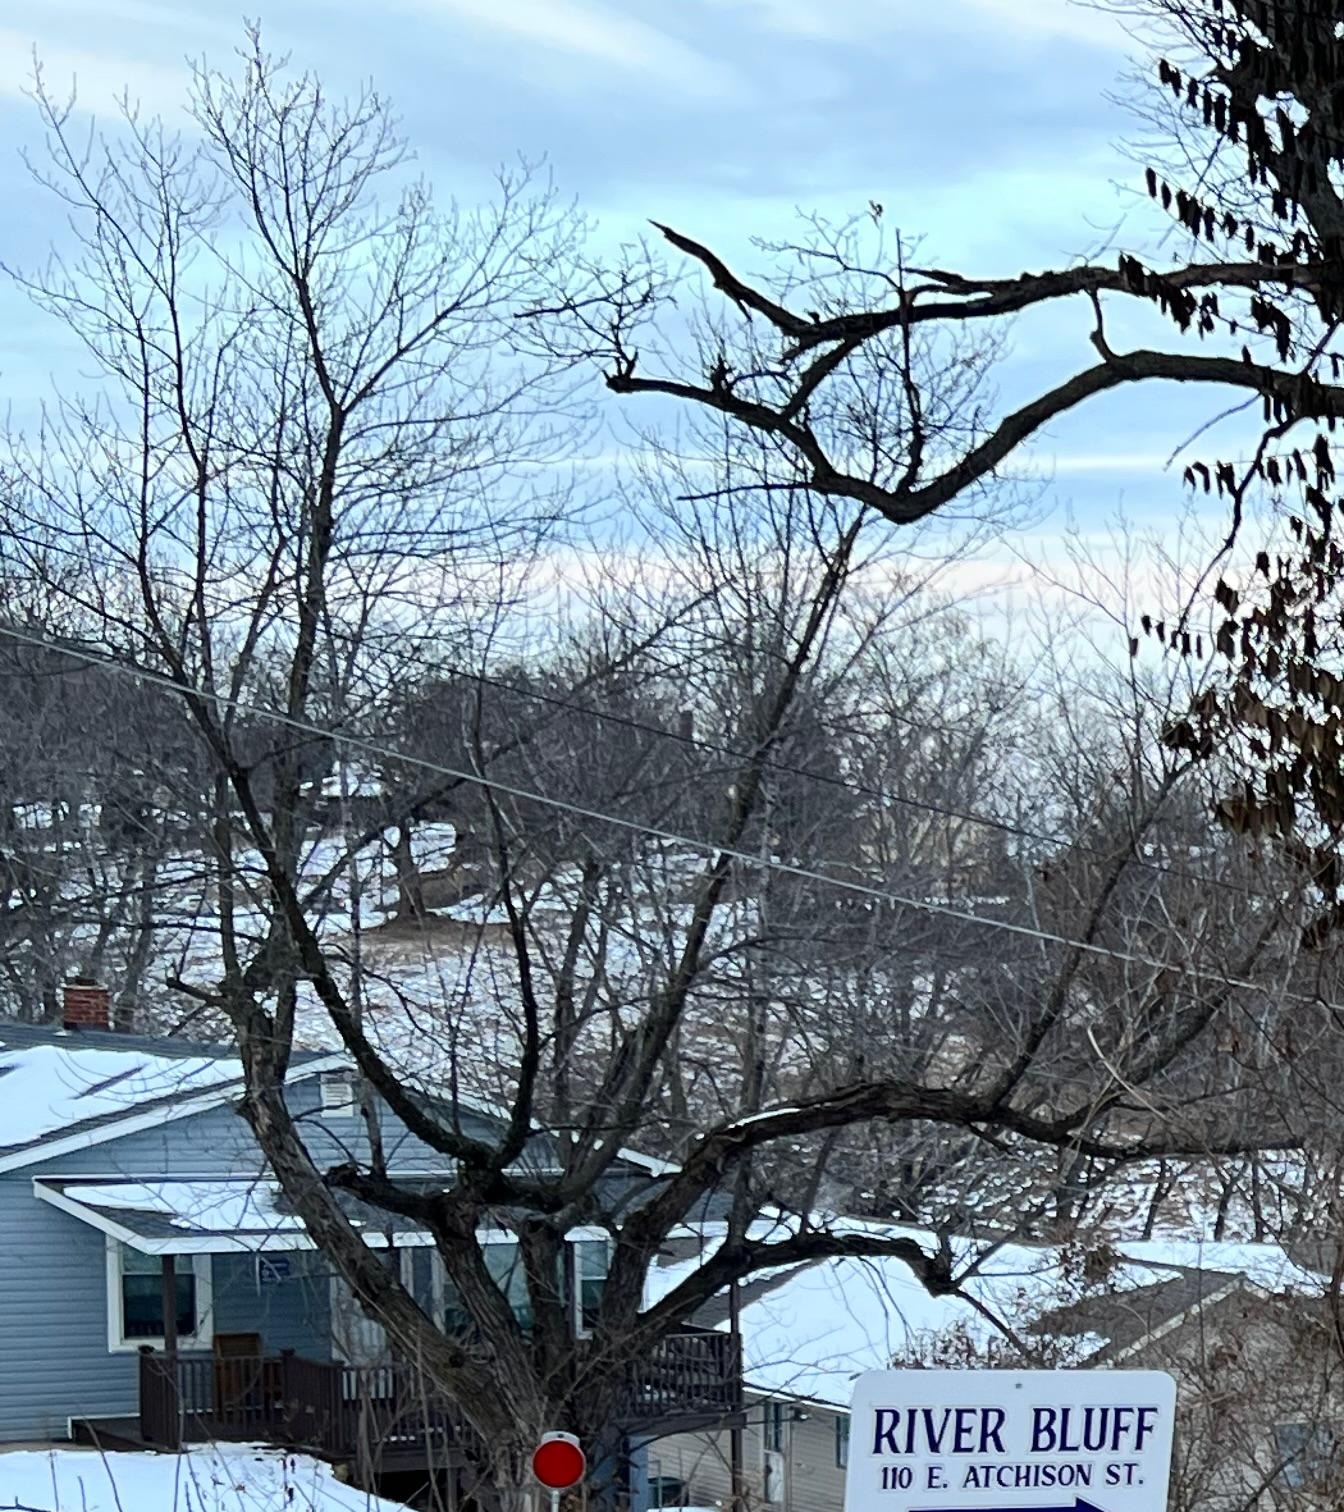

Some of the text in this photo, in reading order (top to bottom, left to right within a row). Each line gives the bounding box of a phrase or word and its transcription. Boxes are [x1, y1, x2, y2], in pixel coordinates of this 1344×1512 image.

[872, 1407, 1158, 1454] RIVER BLUFF
[882, 1463, 1143, 1489] 110 E. ATCHISON ST.
